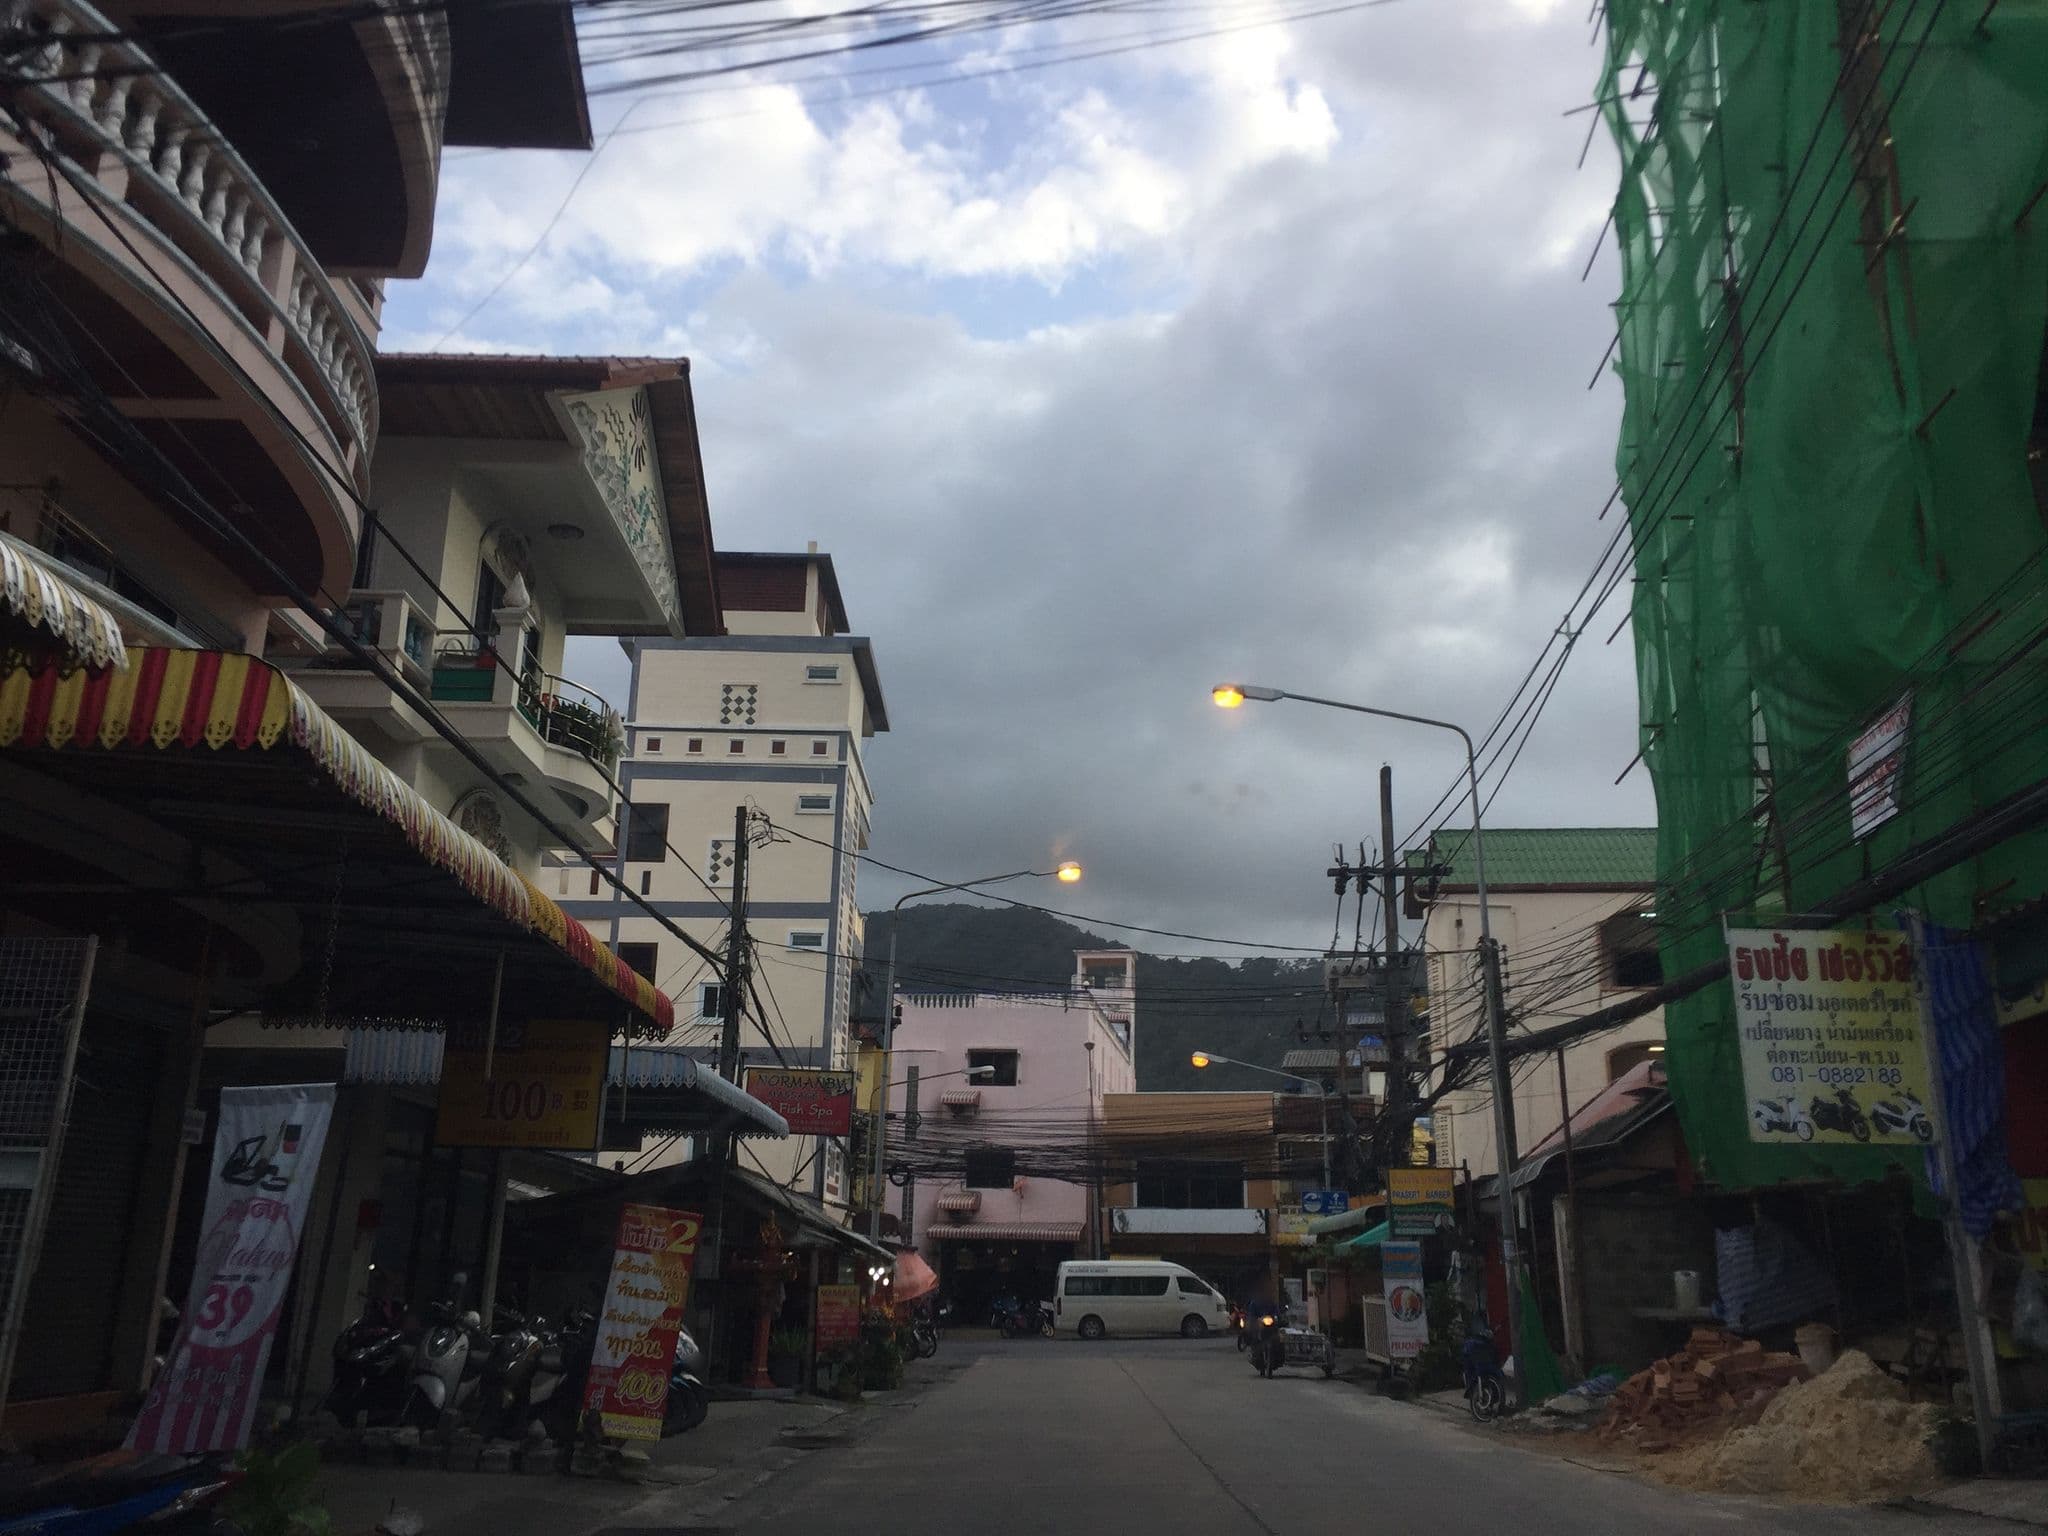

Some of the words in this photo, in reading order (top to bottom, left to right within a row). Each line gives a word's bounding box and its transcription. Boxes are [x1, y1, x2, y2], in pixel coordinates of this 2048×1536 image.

[1740, 983, 1814, 1012] รับซ่อม
[1745, 1011, 1822, 1041] เปลี่ยนยาง
[1771, 1066, 1902, 1084] 081-0882188
[479, 1080, 547, 1122] 100
[779, 1102, 804, 1116] Fish
[809, 1103, 833, 1119] Spa
[668, 1217, 700, 1254] 2
[196, 1284, 253, 1330] 39
[615, 1366, 667, 1402] 100
